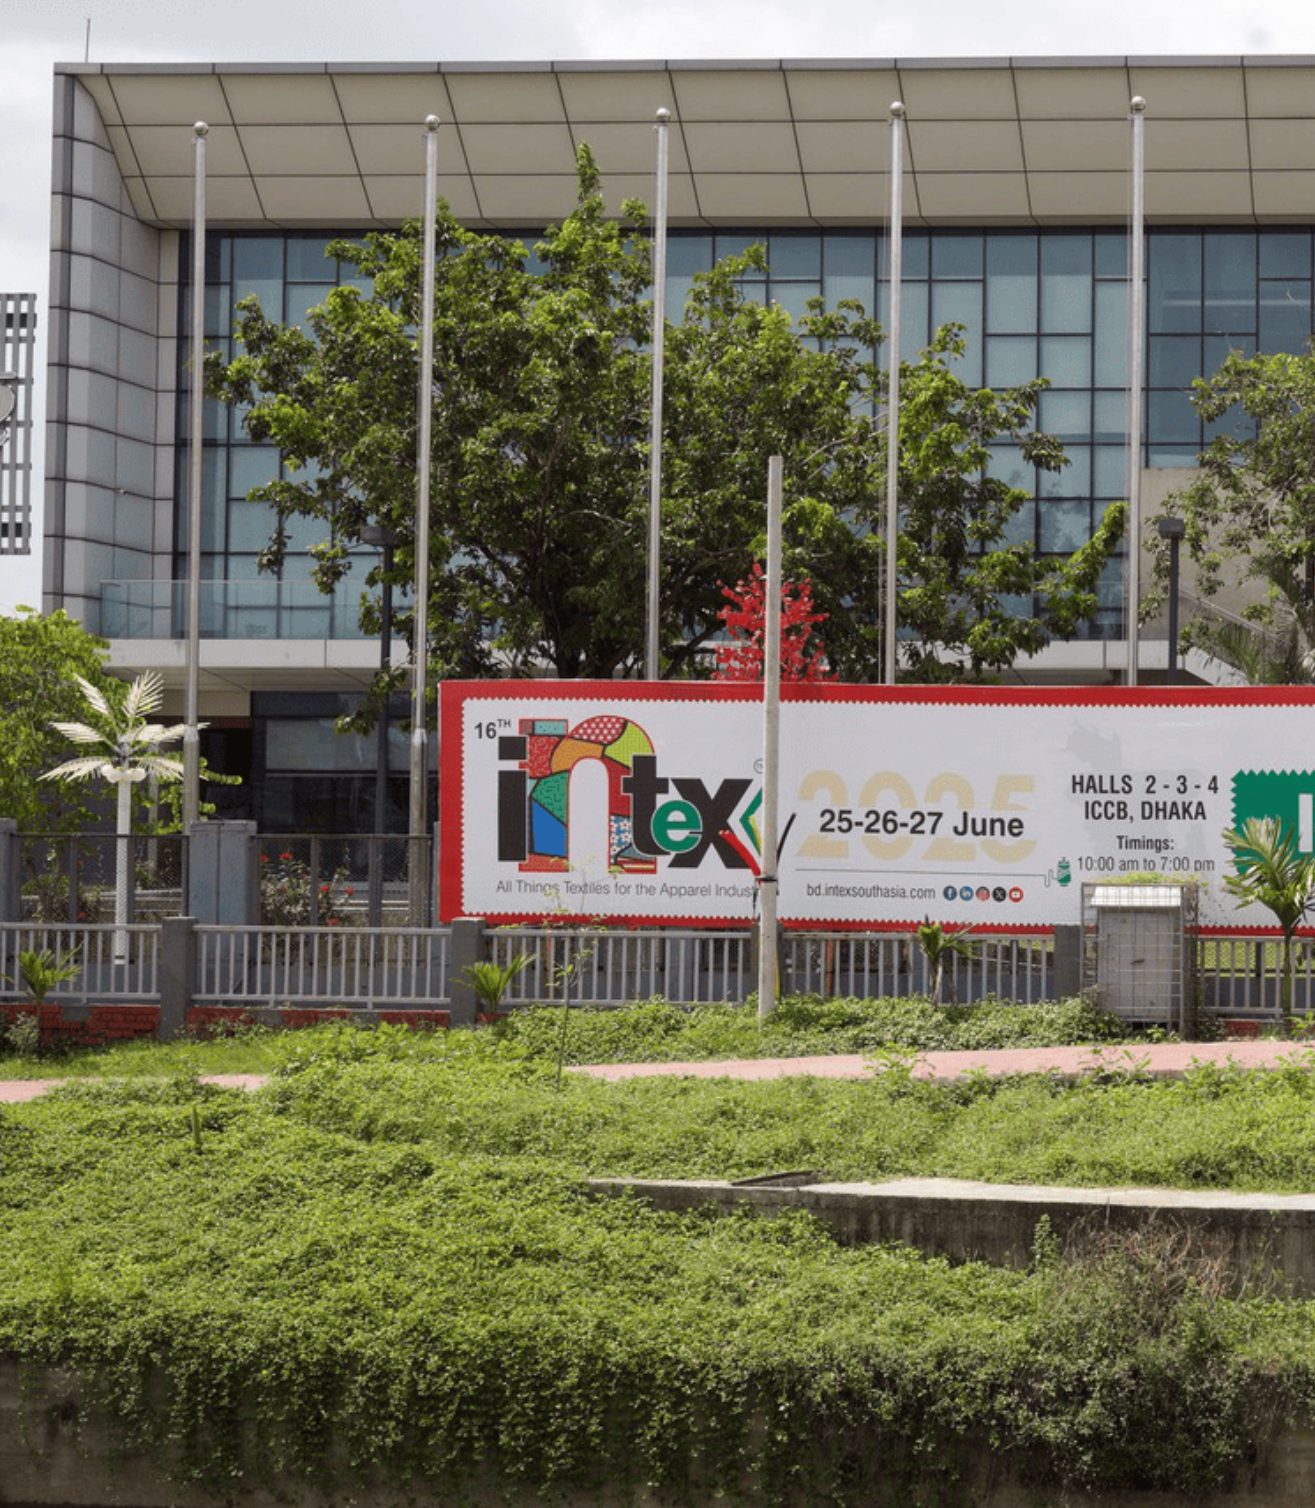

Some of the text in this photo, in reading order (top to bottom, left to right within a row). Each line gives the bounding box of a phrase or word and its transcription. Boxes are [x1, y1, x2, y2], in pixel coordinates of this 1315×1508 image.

[1071, 775, 1133, 794] HALLS
[1145, 776, 1156, 794] 2
[1176, 776, 1187, 794] 3
[1207, 776, 1219, 794] 4
[1084, 801, 1207, 822] ICCB, DHAKA
[819, 809, 1025, 836] 25-26-27 June
[1116, 835, 1174, 853] Timings:
[1077, 856, 1115, 872] 10:00
[1119, 860, 1139, 872] am
[1143, 857, 1156, 872] to
[1160, 856, 1190, 872] 7:00
[496, 880, 761, 899] All Things Textiles for the Apparel Indus
[806, 883, 936, 900] bd.intexsouthasia.com
